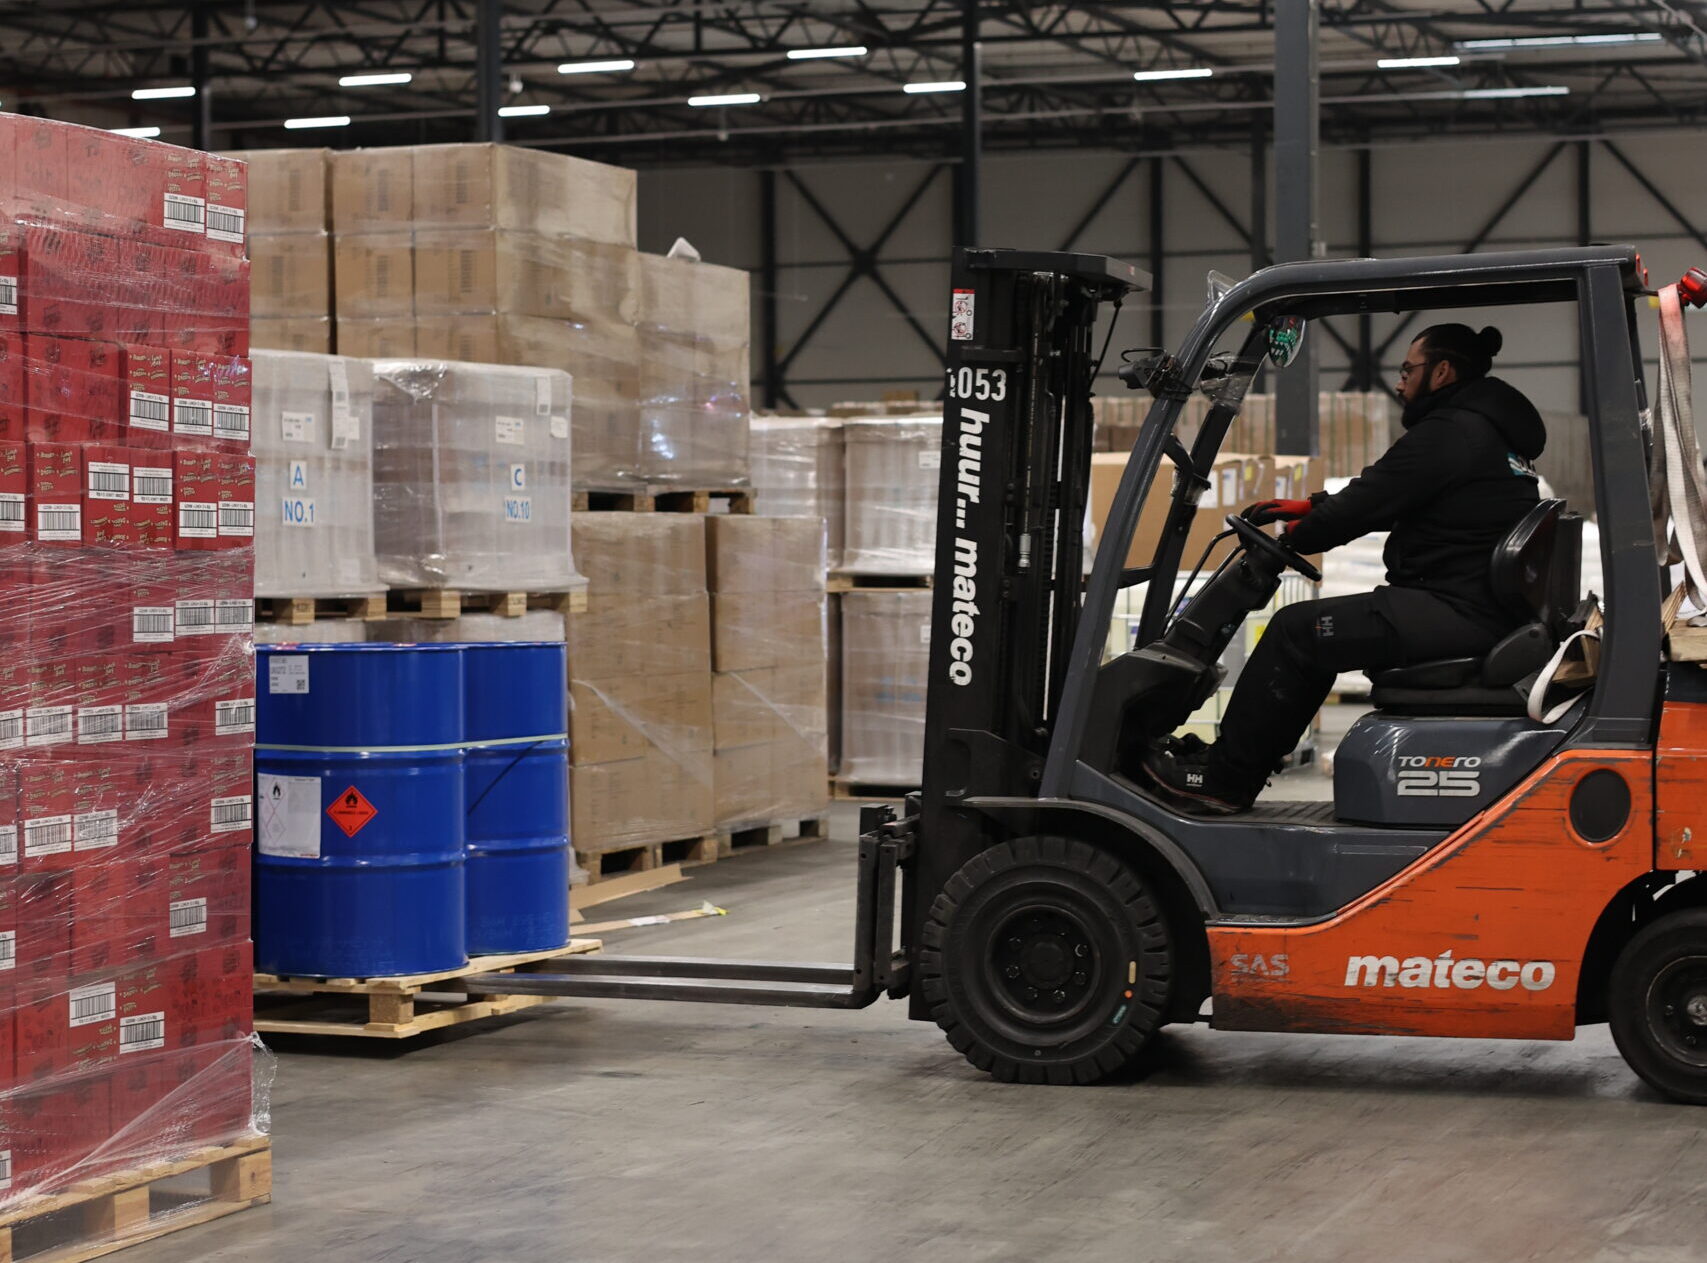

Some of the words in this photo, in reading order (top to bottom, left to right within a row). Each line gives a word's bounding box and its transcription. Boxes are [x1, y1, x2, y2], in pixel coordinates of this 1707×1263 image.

[293, 465, 305, 486] A
[514, 467, 523, 487] C
[283, 500, 315, 523] NO.1
[507, 500, 530, 519] NO.10
[949, 537, 981, 687] mateco
[1186, 773, 1204, 784] HH
[1396, 770, 1481, 797] 25
[1231, 953, 1290, 976] SAS
[1343, 949, 1556, 991] mateco
